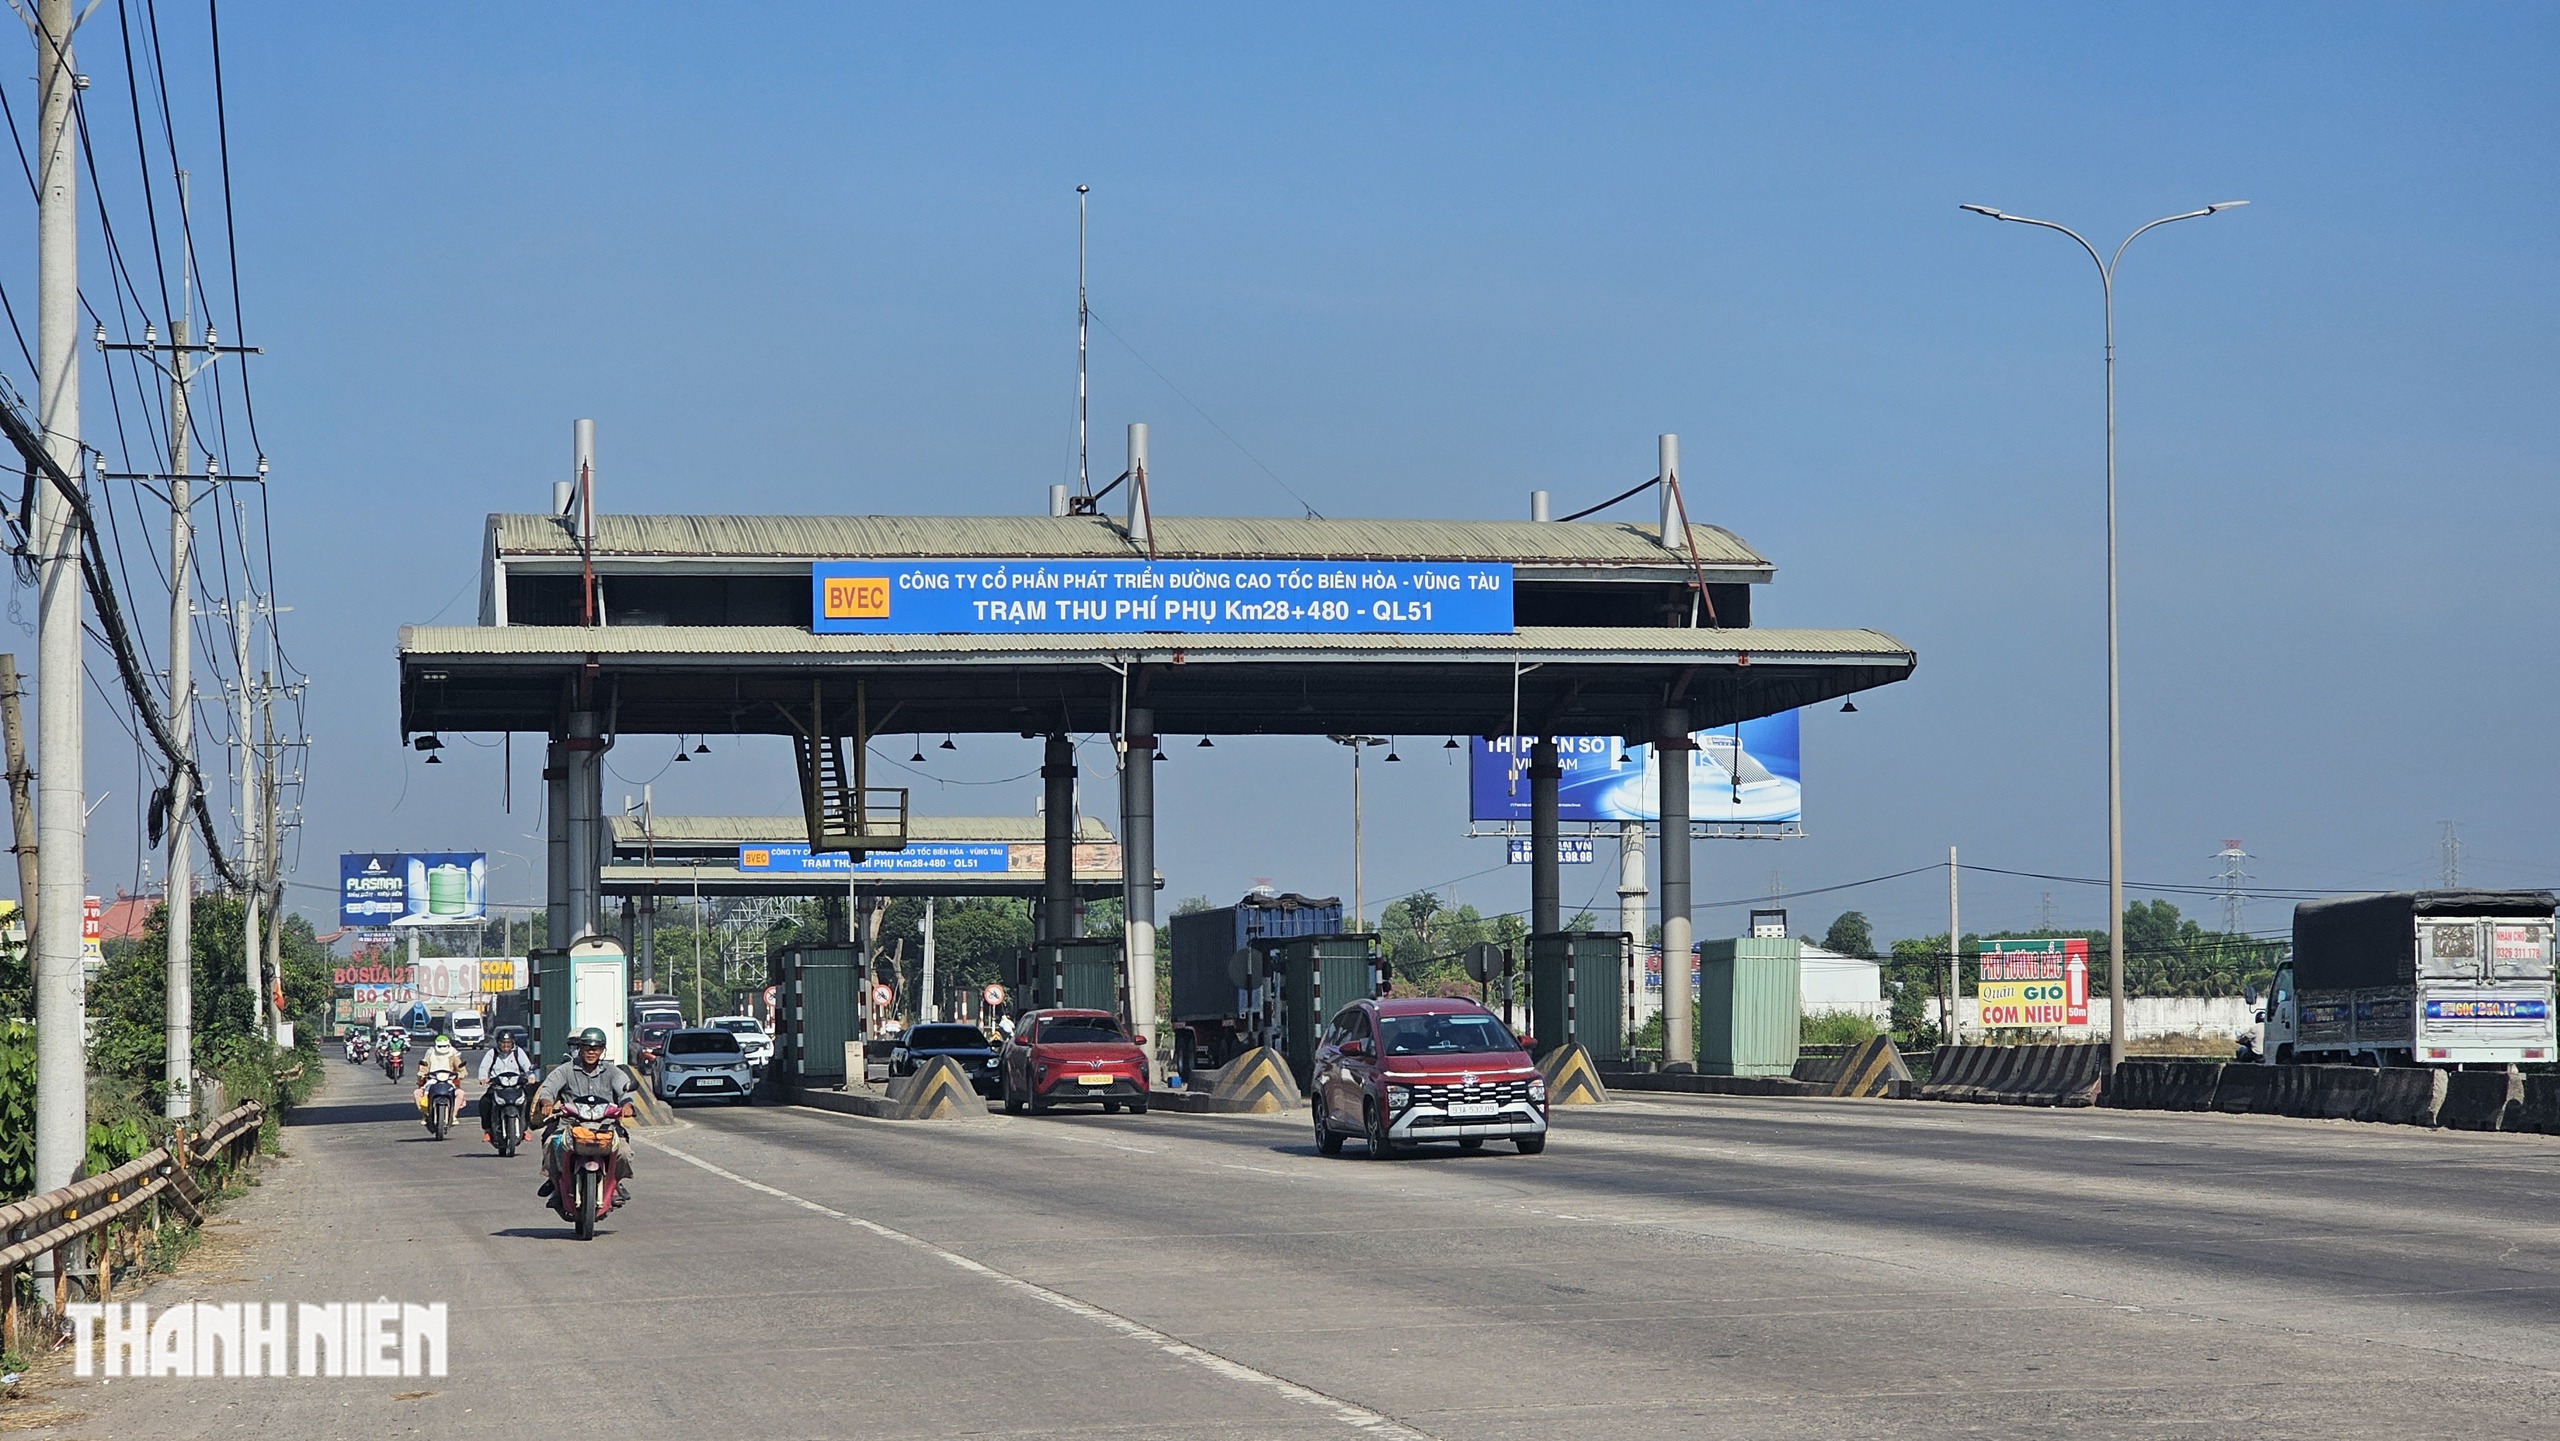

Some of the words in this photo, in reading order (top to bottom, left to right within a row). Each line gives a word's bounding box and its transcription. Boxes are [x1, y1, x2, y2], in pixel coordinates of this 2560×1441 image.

[899, 571, 949, 590] CÔNG
[955, 573, 977, 589] TY
[982, 565, 1007, 590] CỔ
[1012, 566, 1058, 590] PHẦN
[1064, 569, 1107, 589] PHÁT
[1114, 565, 1163, 589] TRIỂN
[1170, 569, 1230, 590] ĐƯỜNG
[1236, 573, 1271, 590] CAO
[1277, 567, 1313, 590] TỐC
[1318, 570, 1356, 590] BIÊN
[1362, 569, 1397, 590] HÒA
[1413, 571, 1460, 591] VŨNG
[1468, 571, 1499, 591] TÀU
[830, 586, 884, 609] BVEC
[973, 600, 1046, 625] TRẠM
[1055, 600, 1106, 621] THU
[1115, 595, 1157, 621] PHÍ
[1165, 600, 1217, 624] PHỤ
[1226, 600, 1349, 621] Km28+480
[1373, 601, 1432, 621] QL51
[746, 853, 766, 862] BVEC
[792, 848, 801, 856] TY
[802, 859, 830, 870] TRẠM
[874, 859, 893, 870] PHỤ
[897, 858, 945, 869] Km28+480
[954, 859, 977, 869] QL51
[346, 877, 403, 891] PLASMAN
[1982, 1006, 2019, 1024] CƠM
[2024, 1001, 2063, 1024] NIÊU
[2068, 1007, 2087, 1018] 50m
